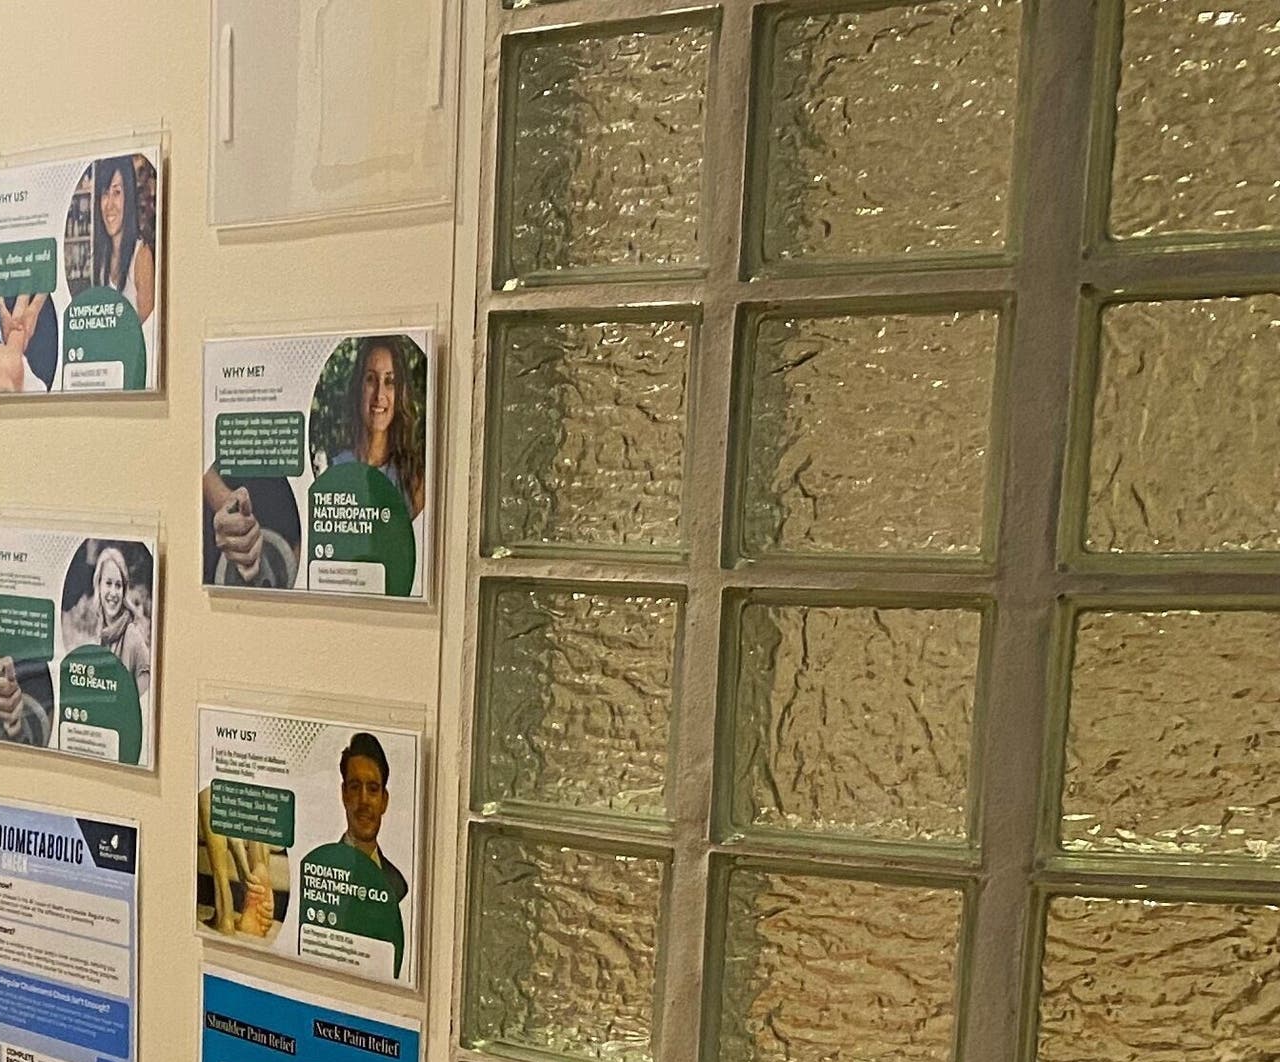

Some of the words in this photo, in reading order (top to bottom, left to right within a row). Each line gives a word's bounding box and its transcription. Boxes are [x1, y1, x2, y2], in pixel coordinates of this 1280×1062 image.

[14, 190, 28, 202] US?
[69, 303, 115, 318] LYMPHCARE
[69, 318, 85, 331] GLO
[85, 315, 117, 330] HEALTH
[222, 367, 245, 379] WHY
[246, 365, 265, 378] ME?
[313, 492, 332, 506] THE
[333, 492, 358, 506] REAL
[313, 508, 380, 520] NATUROPATH
[313, 520, 333, 533] GLO
[334, 520, 372, 534] HEALTH
[12, 552, 28, 563] ME?
[68, 662, 87, 675] JOEY
[70, 674, 86, 687] GLO
[86, 676, 118, 692] HEALTH
[215, 726, 238, 740] WHY
[240, 730, 257, 743] US?
[304, 863, 351, 882] PODIATRY
[303, 888, 340, 906] HEALTH
[368, 888, 389, 903] GLO
[207, 1013, 246, 1037] Shoulder
[247, 1027, 267, 1045] Pain
[268, 1034, 296, 1054] Relief
[315, 1021, 341, 1040] Neck
[343, 1029, 366, 1048] Pain
[368, 1036, 400, 1058] Relief
